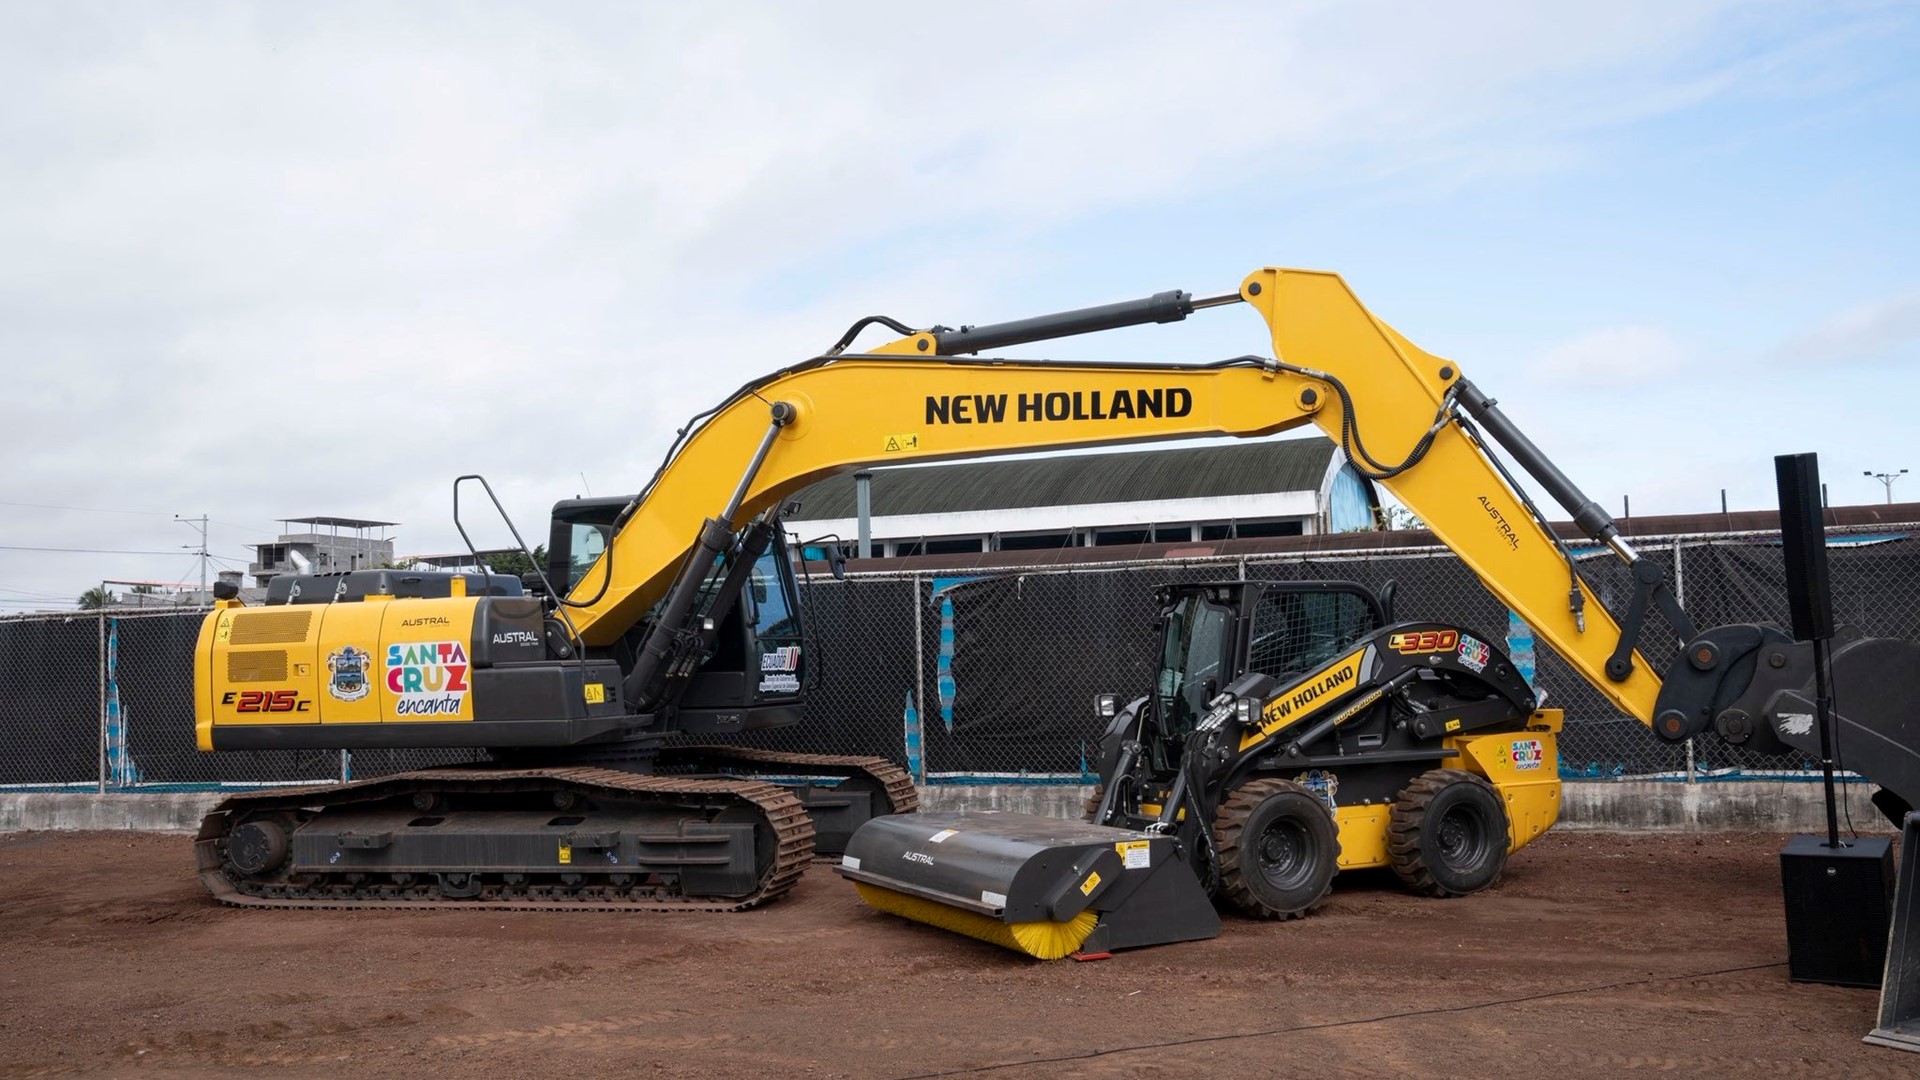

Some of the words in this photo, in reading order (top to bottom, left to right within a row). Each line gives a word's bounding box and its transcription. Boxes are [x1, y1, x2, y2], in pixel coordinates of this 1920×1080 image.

[925, 394, 1007, 425] NEW
[1017, 388, 1192, 422] HOLLAND
[1478, 496, 1519, 549] AUSTRAL
[402, 617, 449, 627] AUSTRAL
[493, 631, 538, 644] AUSTRAL
[1461, 635, 1489, 655] SANTA
[387, 643, 466, 666] SANTA
[1459, 643, 1487, 665] CRUZ
[387, 665, 467, 693] CRUZ
[397, 693, 460, 714] encanta
[1260, 701, 1291, 728] NEW
[1293, 665, 1353, 710] HOLLAND
[1512, 750, 1542, 761] CRUZ
[903, 851, 934, 865] AUSTRAL
